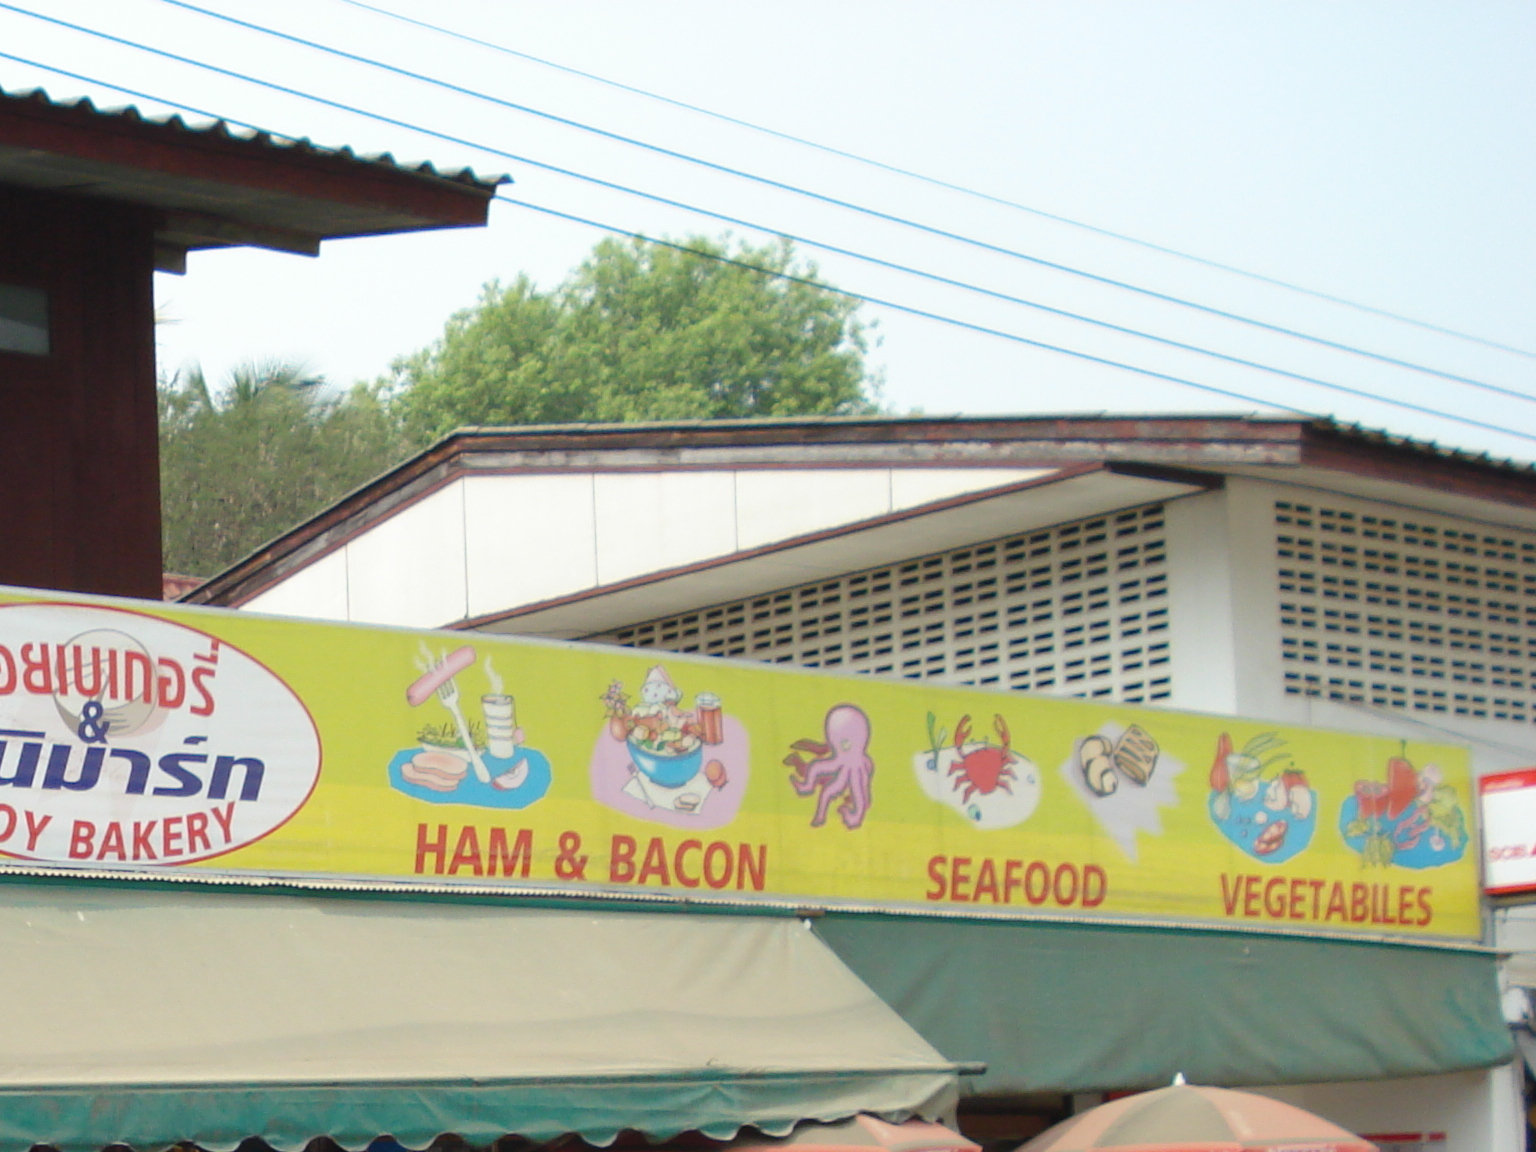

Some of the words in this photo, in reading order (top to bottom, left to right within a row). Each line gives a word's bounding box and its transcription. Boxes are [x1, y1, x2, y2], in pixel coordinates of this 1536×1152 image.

[78, 701, 110, 744] &
[68, 801, 236, 861] BAKERY
[413, 822, 534, 878] HAM
[554, 830, 588, 881] &
[609, 833, 768, 891] BACON
[925, 854, 1109, 908] SEAFOOD
[1221, 873, 1433, 927] VEGETABILES
